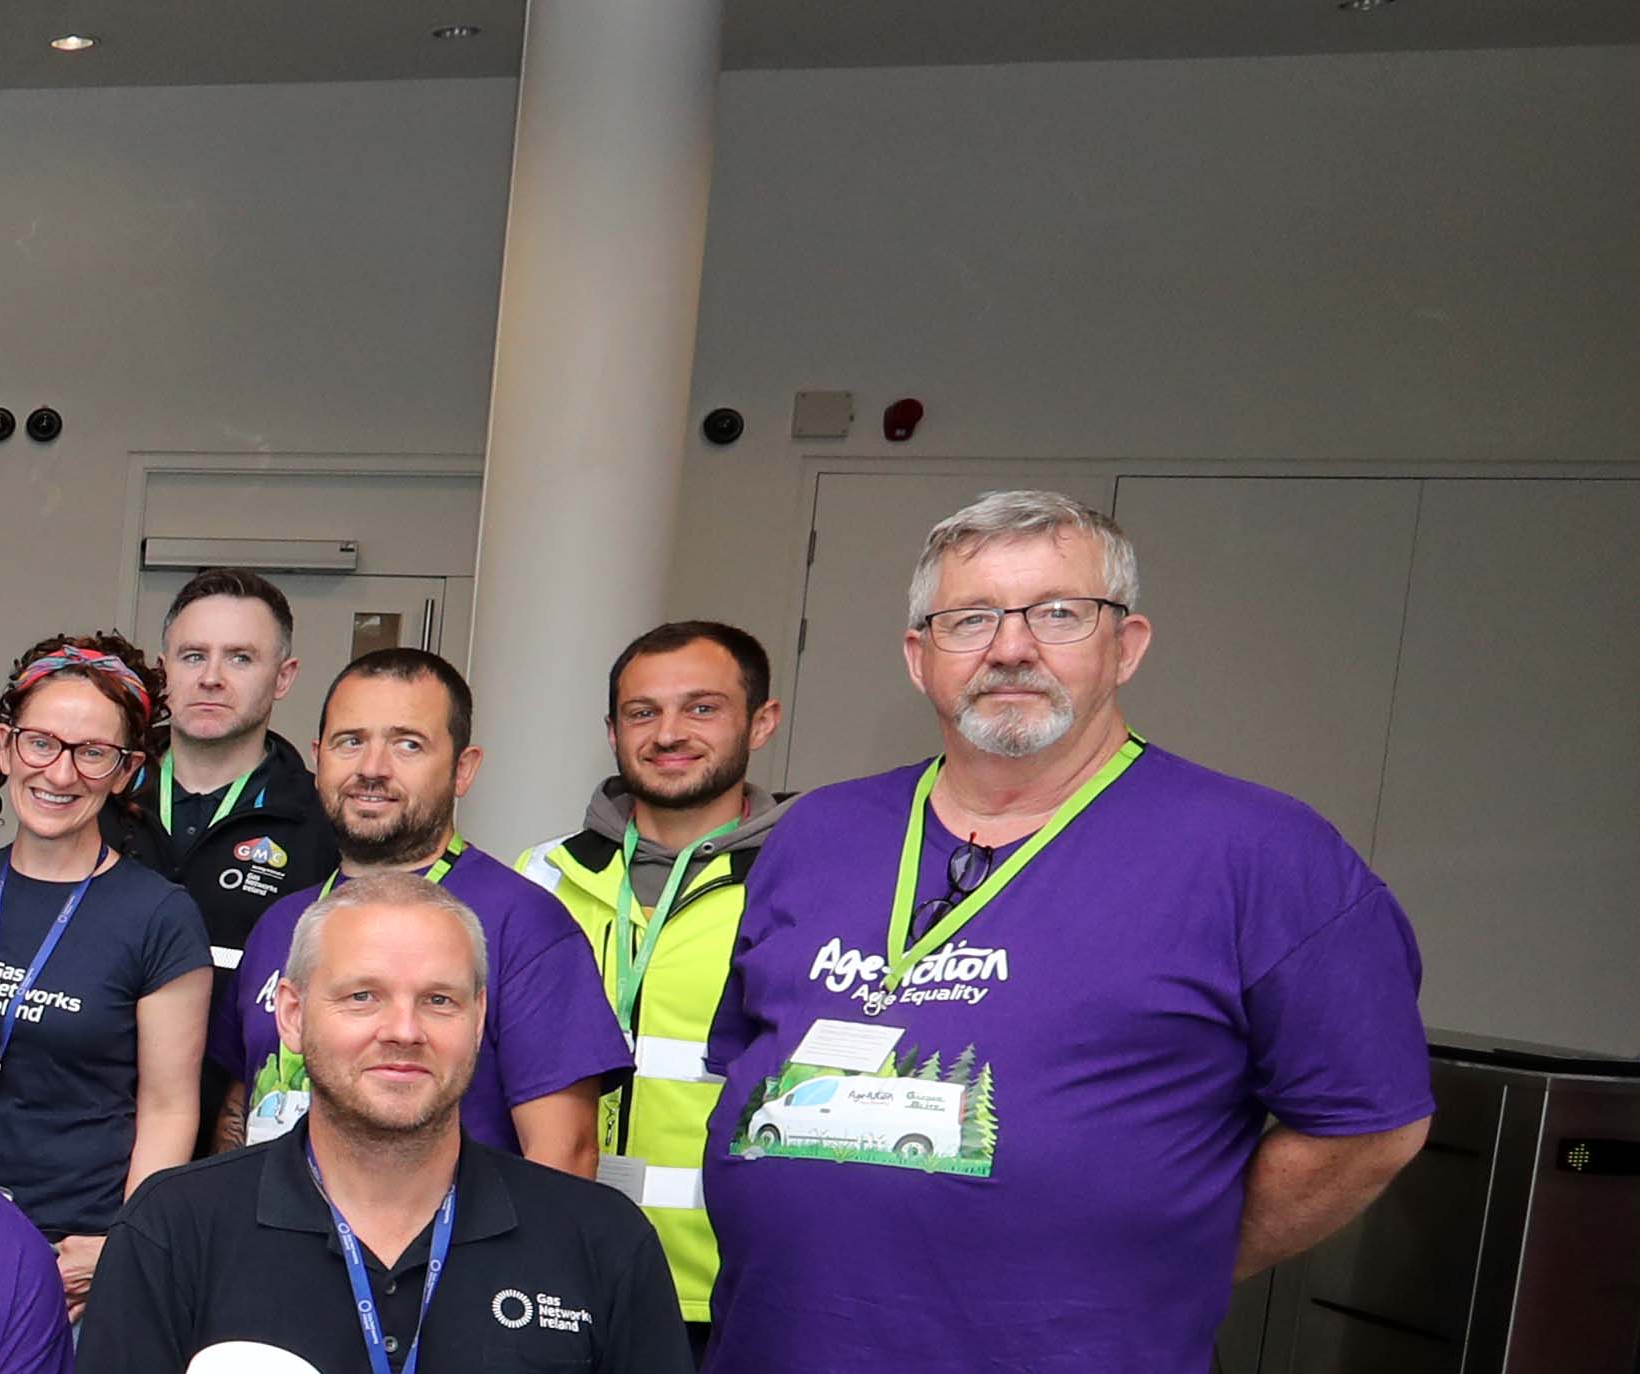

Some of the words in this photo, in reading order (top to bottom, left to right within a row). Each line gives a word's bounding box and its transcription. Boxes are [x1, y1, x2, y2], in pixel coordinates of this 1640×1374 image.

[237, 845, 283, 864] GMC
[899, 983, 989, 1006] Equality
[536, 1293, 562, 1306] Gas
[540, 1316, 580, 1333] Ireland
